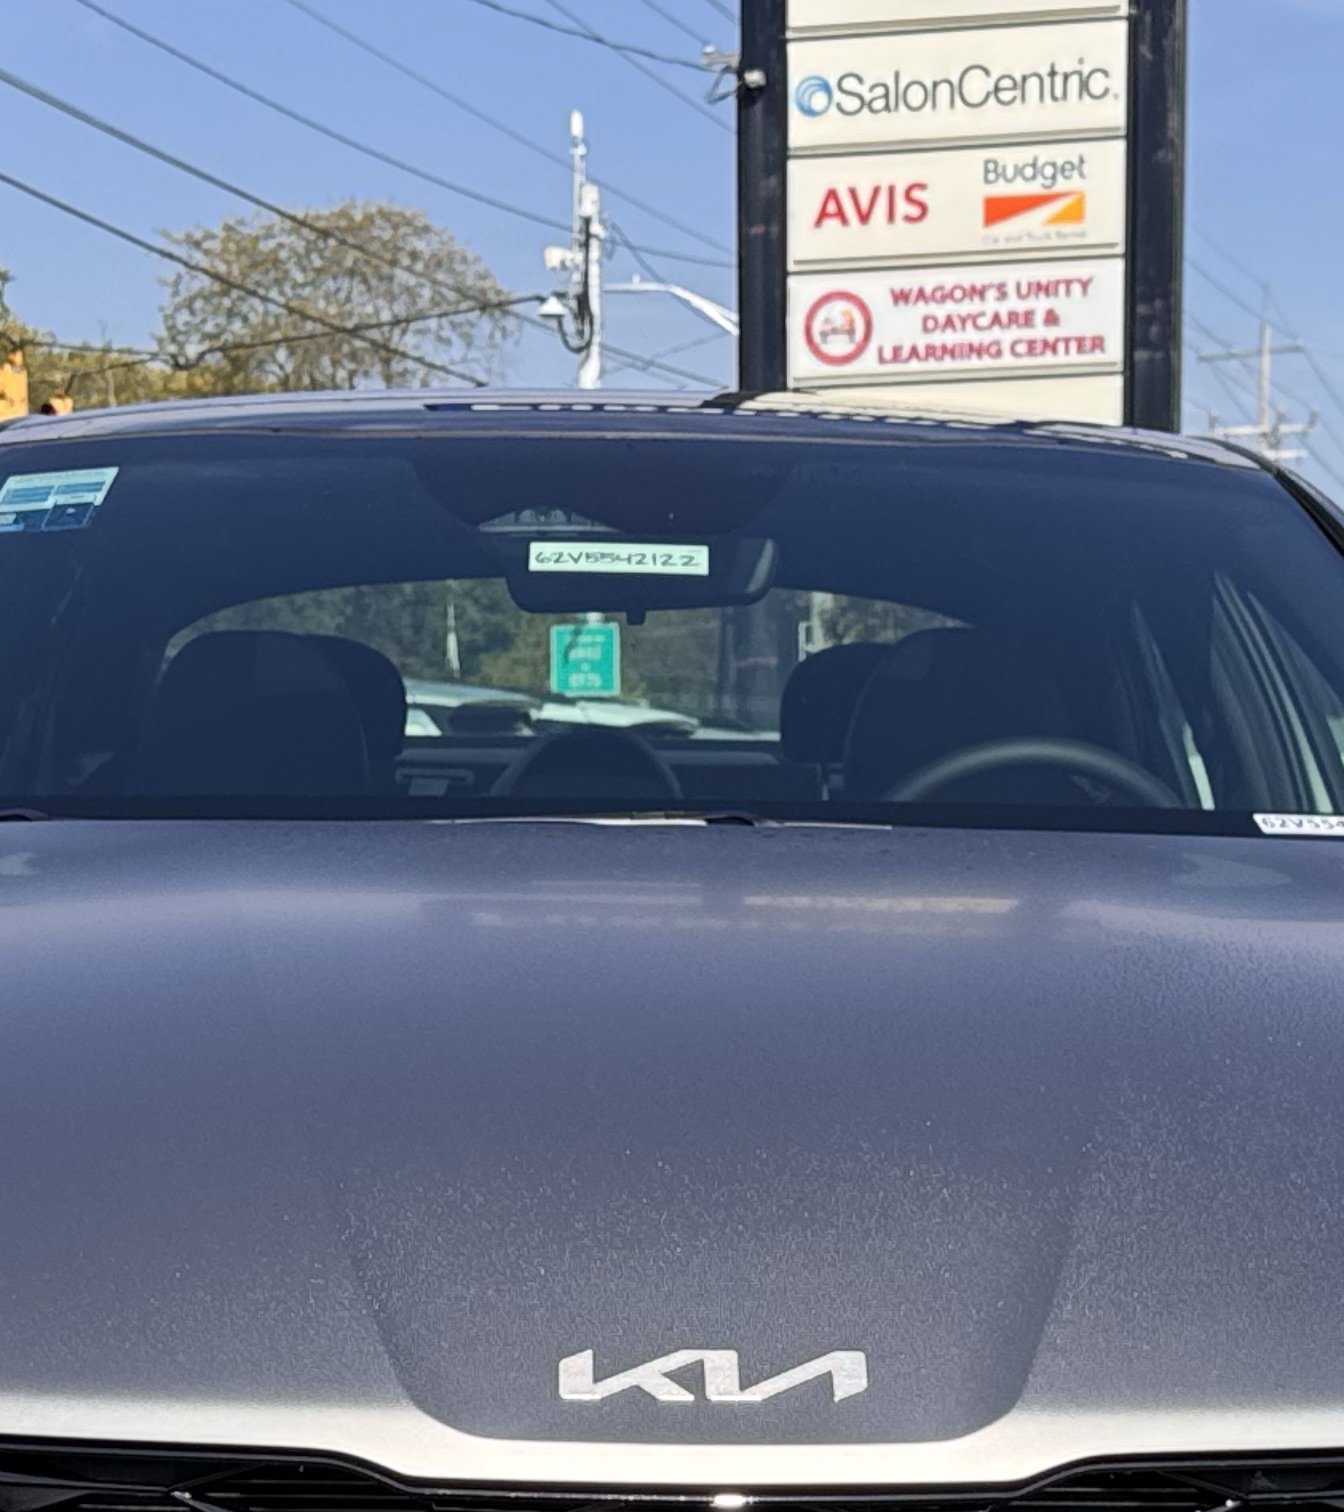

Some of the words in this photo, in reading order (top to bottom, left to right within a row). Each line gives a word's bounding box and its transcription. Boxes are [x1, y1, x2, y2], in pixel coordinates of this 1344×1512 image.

[982, 154, 1087, 190] Budget
[813, 182, 929, 229] AVIS
[890, 282, 1007, 306] WAGON'S
[1016, 277, 1094, 300] UNITY
[922, 309, 1036, 334] DAYCARE
[1043, 307, 1061, 328] &
[878, 341, 1003, 365] LEARNING
[1010, 334, 1105, 358] CENTER
[558, 1348, 869, 1403] KIA
